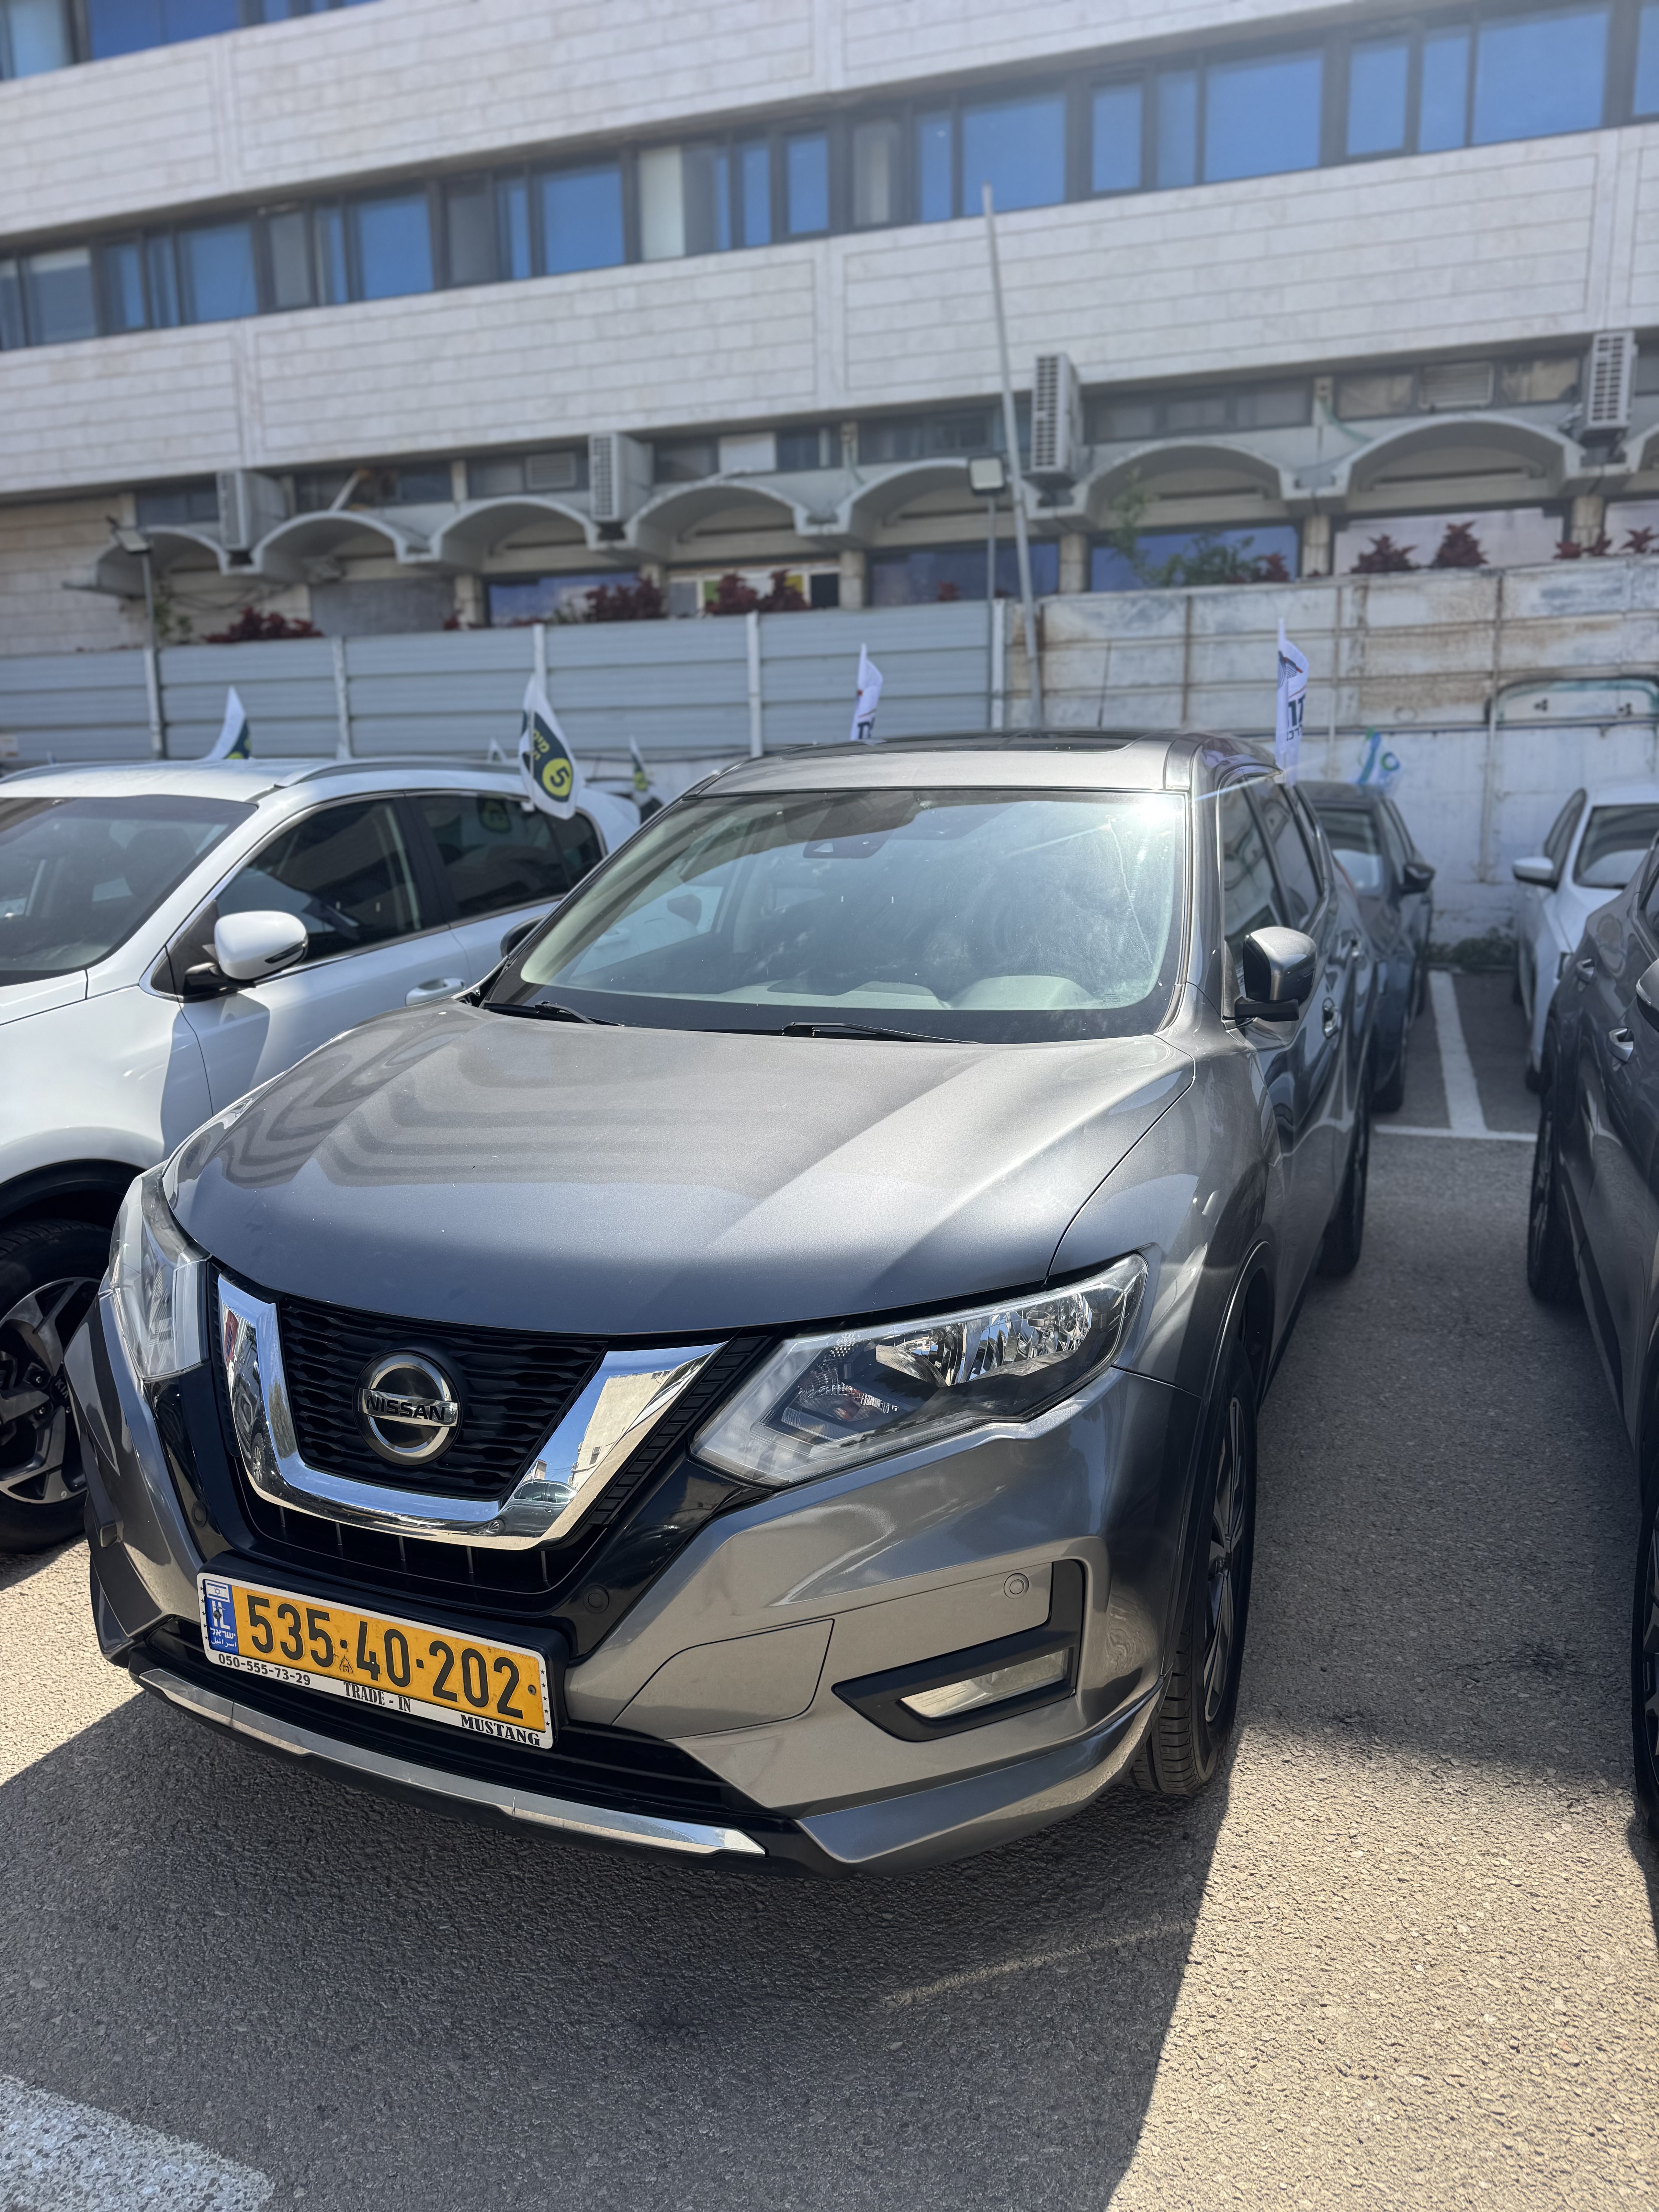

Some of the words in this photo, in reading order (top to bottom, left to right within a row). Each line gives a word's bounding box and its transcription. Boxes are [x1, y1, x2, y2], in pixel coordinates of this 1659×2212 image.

[550, 767, 570, 787] 5
[366, 1396, 445, 1421] NISSAN
[212, 1600, 230, 1630] IL
[210, 1627, 236, 1639] ישראל
[218, 1654, 310, 1685] 050-555-73-29
[398, 1695, 411, 1712] IN
[460, 1714, 540, 1746] MUSTANG
